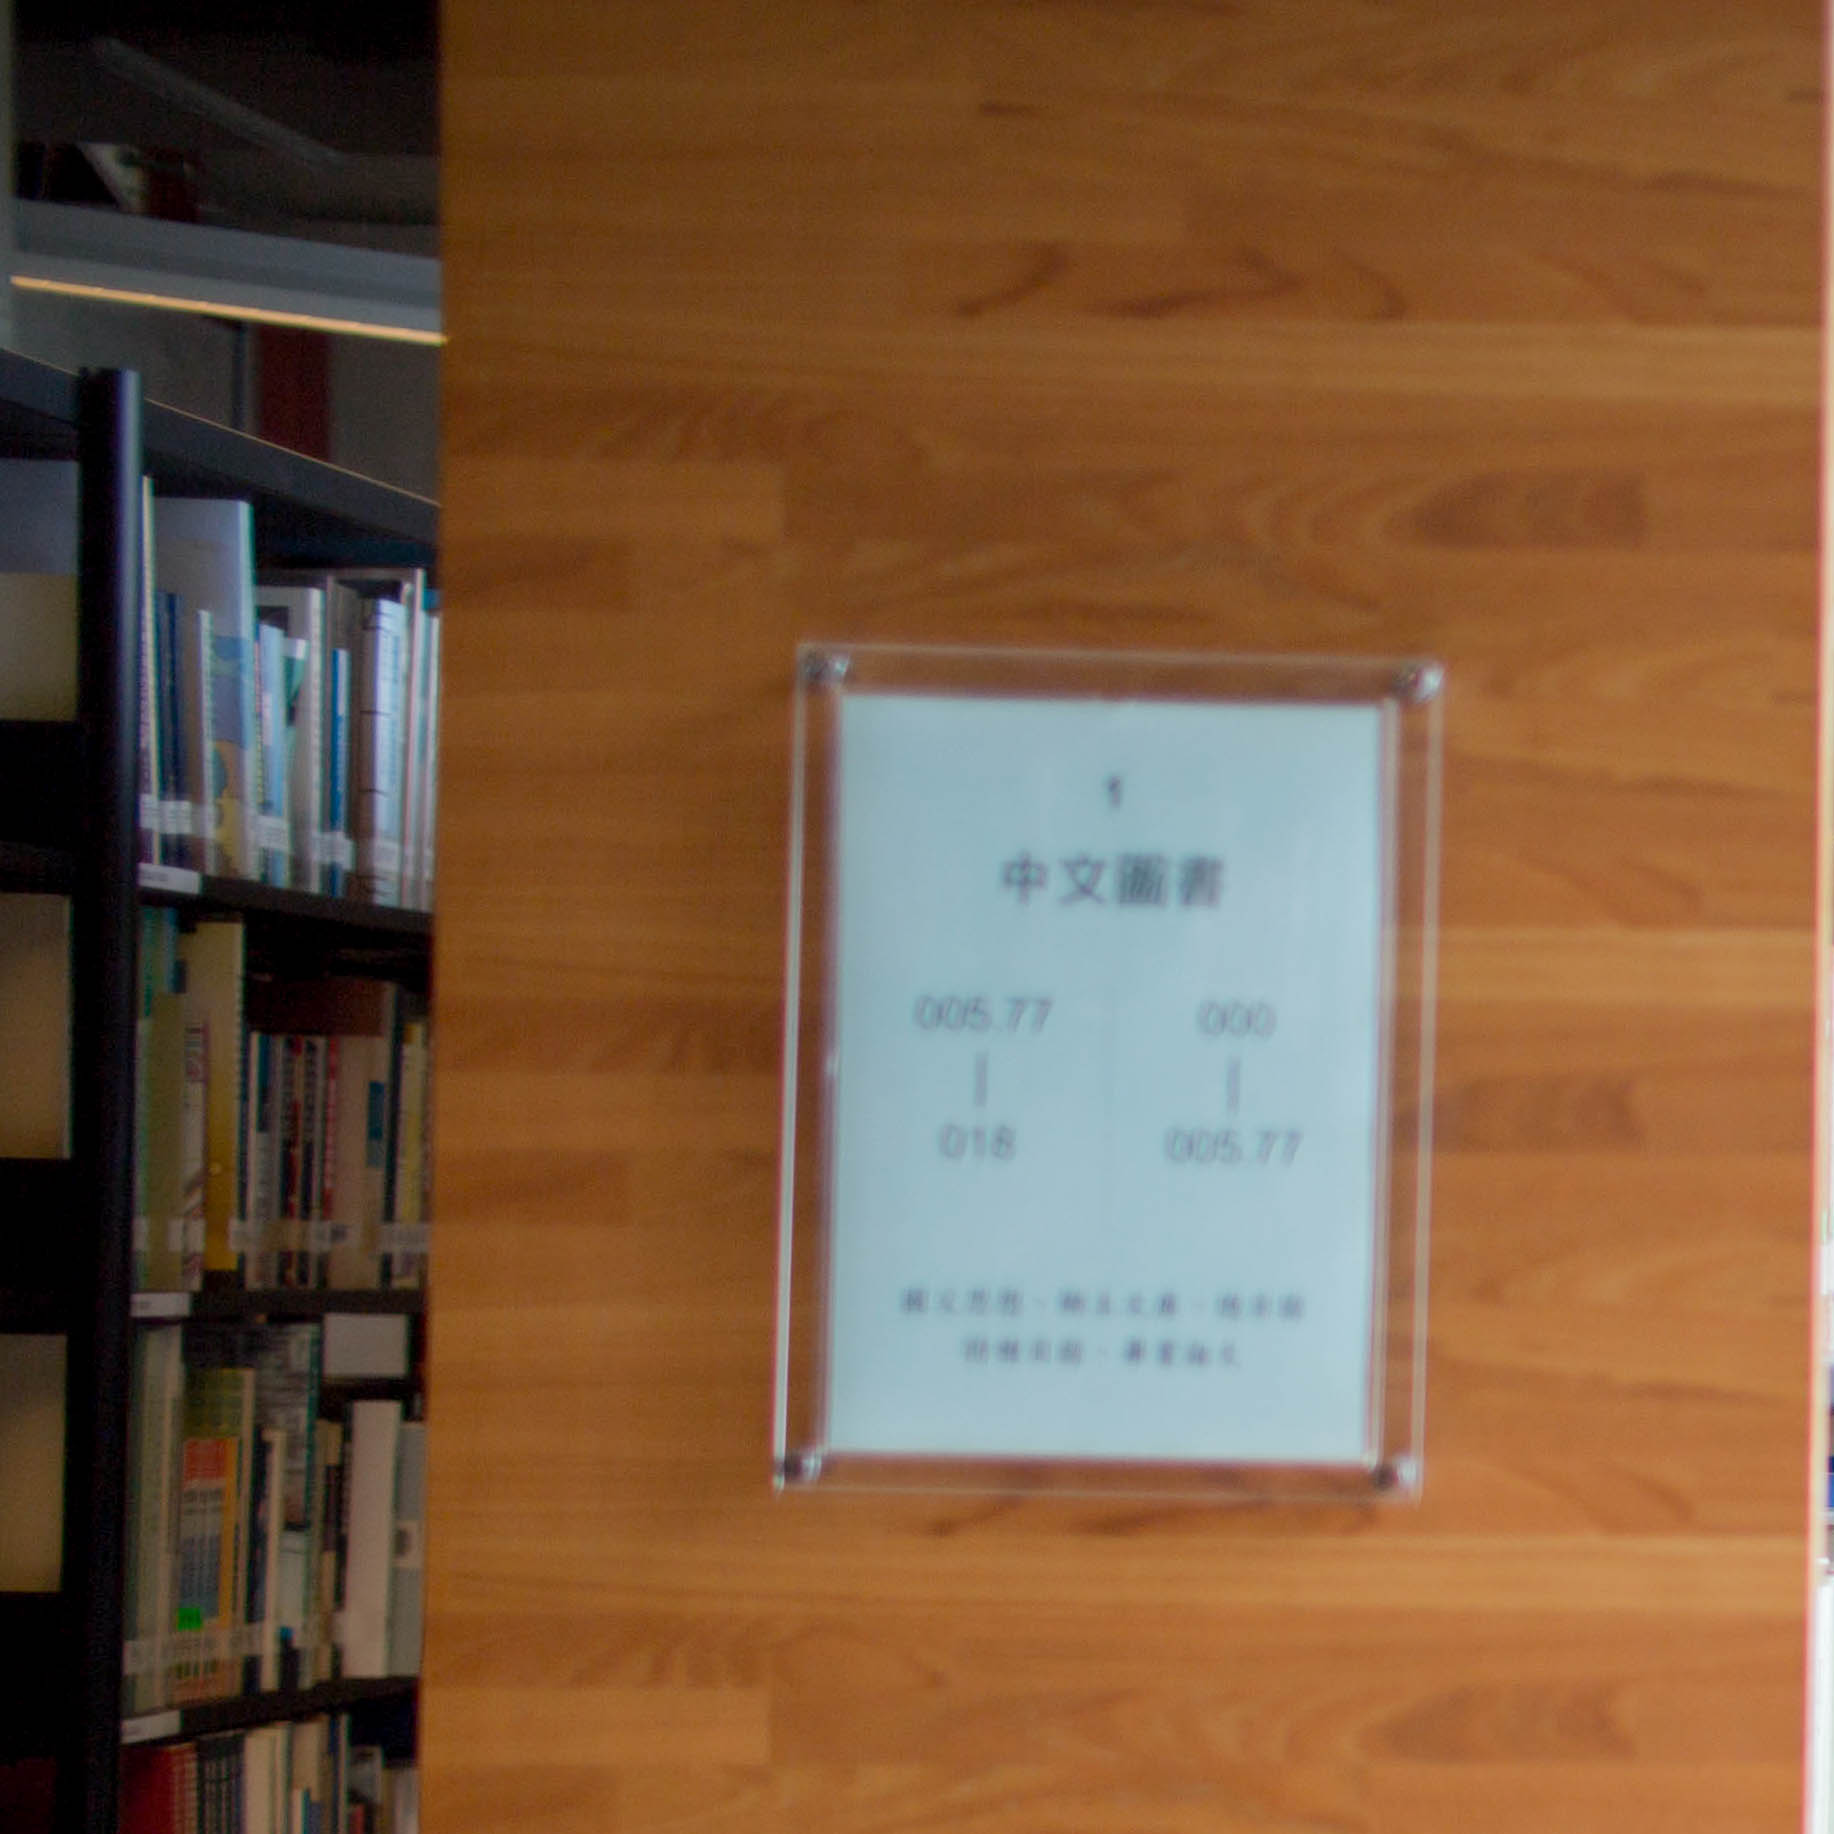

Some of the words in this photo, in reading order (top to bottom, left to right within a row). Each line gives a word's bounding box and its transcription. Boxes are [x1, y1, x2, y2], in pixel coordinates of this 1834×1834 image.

[914, 996, 1053, 1031] 005.77
[1199, 1002, 1277, 1037] 000
[1165, 1129, 1302, 1165] 005.77
